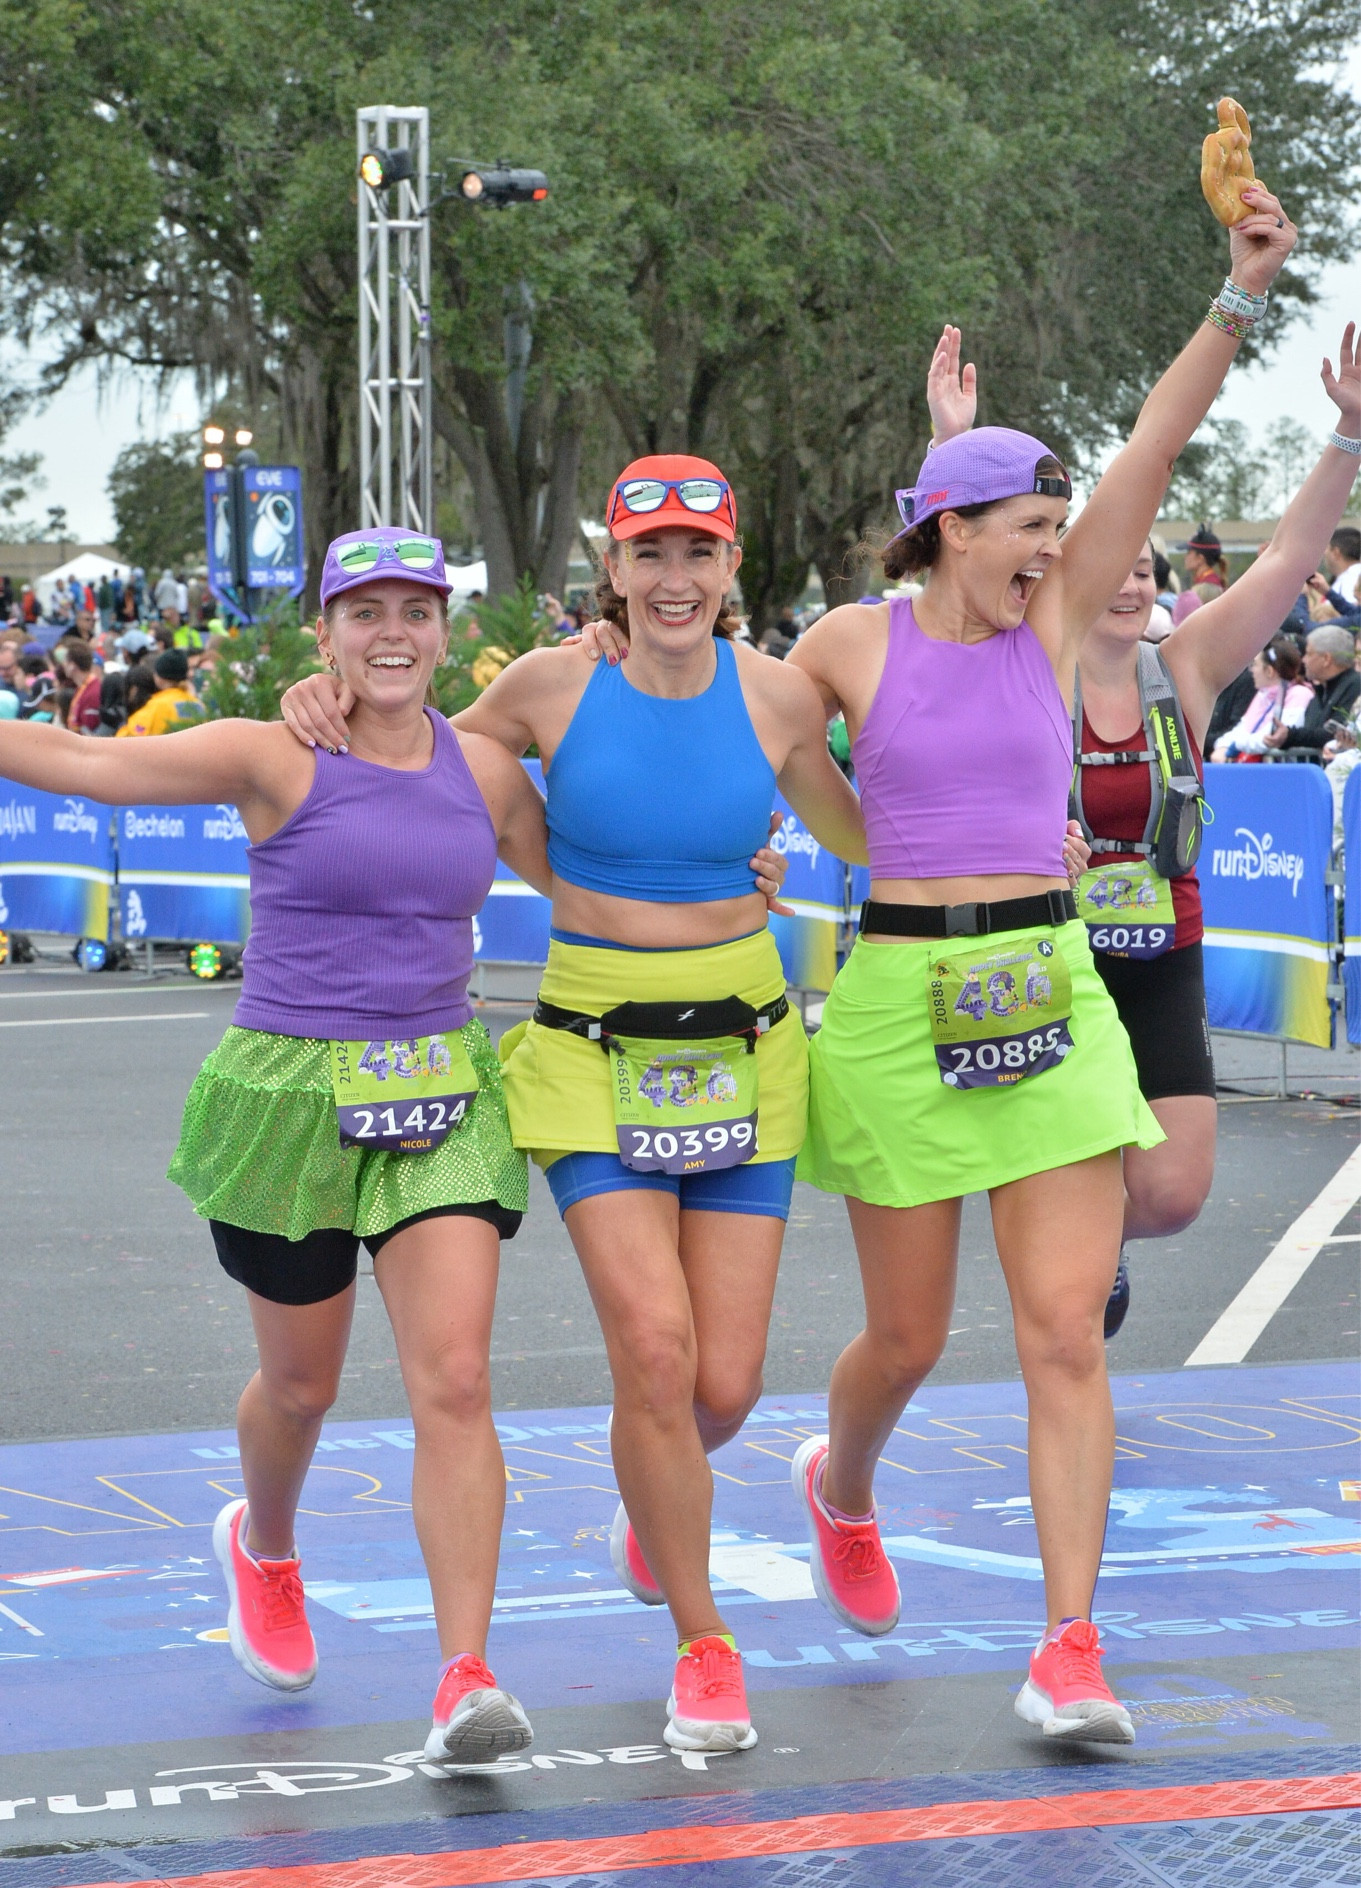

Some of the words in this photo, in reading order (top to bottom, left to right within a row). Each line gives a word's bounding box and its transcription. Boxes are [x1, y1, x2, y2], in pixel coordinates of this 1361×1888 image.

[1042, 942, 1052, 955] A
[1087, 928, 1166, 949] 6019
[931, 980, 948, 1025] 20888
[617, 1059, 631, 1104] 20399
[353, 1100, 466, 1138] 21424
[400, 1138, 432, 1149] NICOLE
[632, 1122, 753, 1159] 20399
[684, 1160, 706, 1170] AMY
